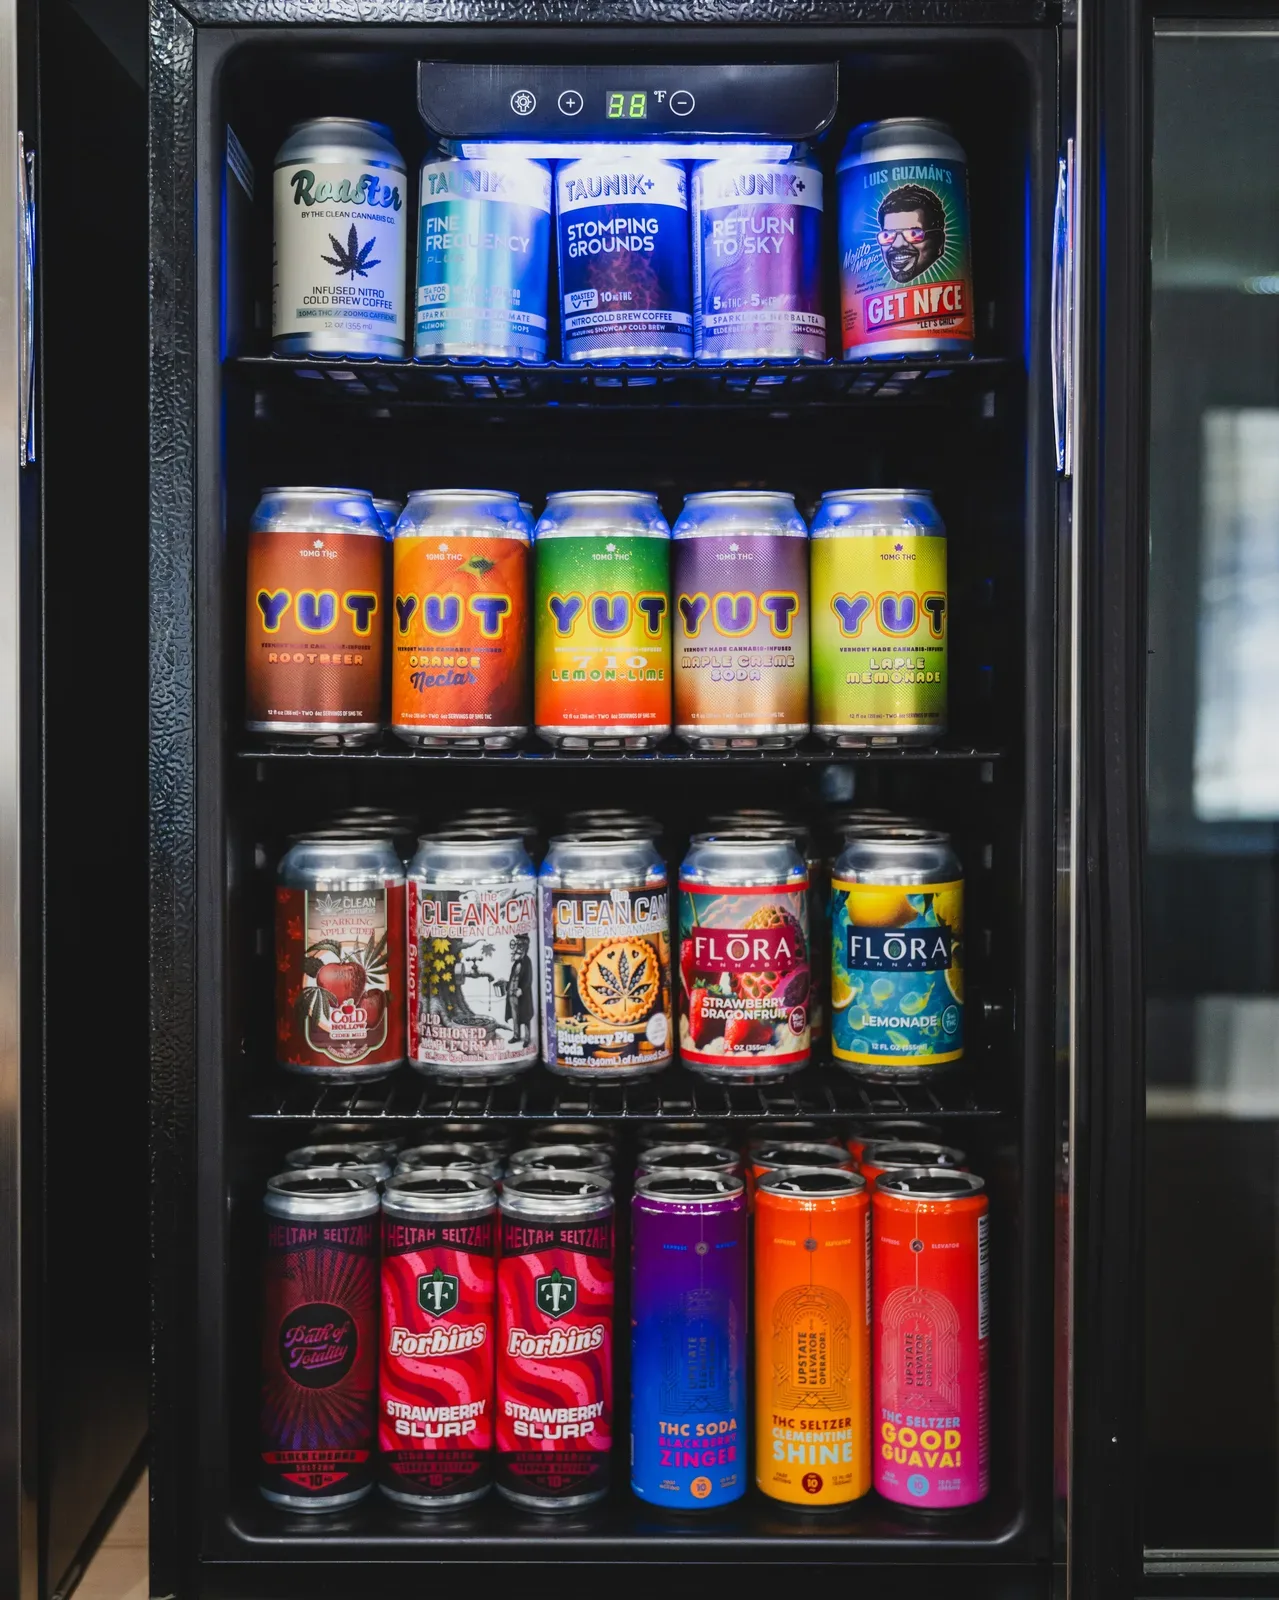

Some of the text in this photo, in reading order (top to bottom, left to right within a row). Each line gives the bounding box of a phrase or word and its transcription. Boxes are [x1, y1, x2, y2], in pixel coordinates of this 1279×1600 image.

[608, 93, 646, 118] 38
[863, 169, 888, 189] LUIS
[291, 169, 403, 212] Roaster
[301, 211, 309, 219] BY
[326, 210, 350, 218] CLEAN
[351, 211, 386, 223] CANNABIS
[426, 216, 460, 234] FINE
[567, 217, 659, 241] STOMPING
[712, 216, 795, 238] RETURN
[425, 233, 530, 253] FREQUENCY
[568, 235, 655, 258] GROUNDS
[712, 236, 785, 257] TO SKY
[843, 242, 871, 272] Mojito
[853, 253, 880, 274] Magic
[312, 286, 386, 299] INFUSED NITRO
[424, 294, 446, 302] TWO
[570, 291, 595, 302] ROASTED
[303, 295, 393, 310] COLD BREW COFFEE
[572, 299, 593, 309] VT
[868, 292, 908, 324] GET
[298, 309, 368, 318] 10MG THC 200MG
[571, 312, 673, 327] NITRO COLD BREW COFFEE
[713, 313, 766, 324] SPARKLING
[808, 315, 819, 324] TEA
[512, 325, 529, 333] HOPS
[299, 550, 338, 559] 10MG THC
[425, 553, 463, 561] 10MG THC
[592, 553, 630, 561] 10MG THC
[880, 553, 917, 561] 10MG THC
[256, 587, 378, 638] YUT
[395, 592, 513, 640] YUT
[547, 591, 668, 641] YUT
[677, 590, 800, 639] YUT
[830, 590, 947, 641] YUT
[268, 652, 363, 666] ROOTBEER
[409, 655, 481, 669] ORANGE
[681, 654, 795, 669] MAPLE CREME
[869, 657, 925, 670] LAPLE
[409, 669, 479, 693] Nectar
[551, 669, 664, 682] LEMON-LIME
[710, 669, 761, 682] SODA
[846, 671, 941, 685] MEMONADE
[343, 897, 376, 909] CLEAN
[480, 892, 497, 902] the
[421, 900, 499, 926] CLEAN
[556, 899, 632, 926] CLEAN
[320, 917, 374, 927] SPARKLING
[320, 927, 375, 937] APPLE CIDER
[448, 926, 487, 937] CLEAN
[701, 996, 786, 1010] STRAWBERRY
[420, 1013, 441, 1025] OLD
[700, 1006, 788, 1020] DRAGONFRUIT
[861, 1014, 938, 1028] LEMONADE
[420, 1025, 487, 1039] FASHIONED
[557, 1042, 584, 1056] Soda
[880, 1043, 889, 1051] FL
[890, 1043, 901, 1051] OZ
[387, 1223, 491, 1248] HELTAH SELTZAH
[505, 1224, 608, 1249] HELTAH SELTZAH
[389, 1322, 488, 1358] Forbins
[508, 1324, 605, 1358] Forbins
[797, 1331, 807, 1385] UPSTATE
[809, 1332, 817, 1385] ELEVATOR
[904, 1332, 914, 1386] UPSTATE
[915, 1333, 924, 1387] ELEVATOR
[386, 1399, 486, 1422] STRAWBERRY
[504, 1400, 604, 1424] STRAWBERRY
[881, 1408, 961, 1429] THC SELTZER
[395, 1419, 477, 1439] SLURP
[513, 1420, 595, 1440] SLURP
[658, 1418, 738, 1437] THC SODA
[771, 1414, 852, 1431] THC SELTZER
[658, 1433, 737, 1448] BLACKBERRY
[771, 1427, 853, 1443] CLEMENTINE
[881, 1421, 962, 1451] GOOD
[659, 1445, 738, 1469] ZINGER
[772, 1440, 853, 1465] SHINE
[881, 1443, 962, 1469] GUAVA!
